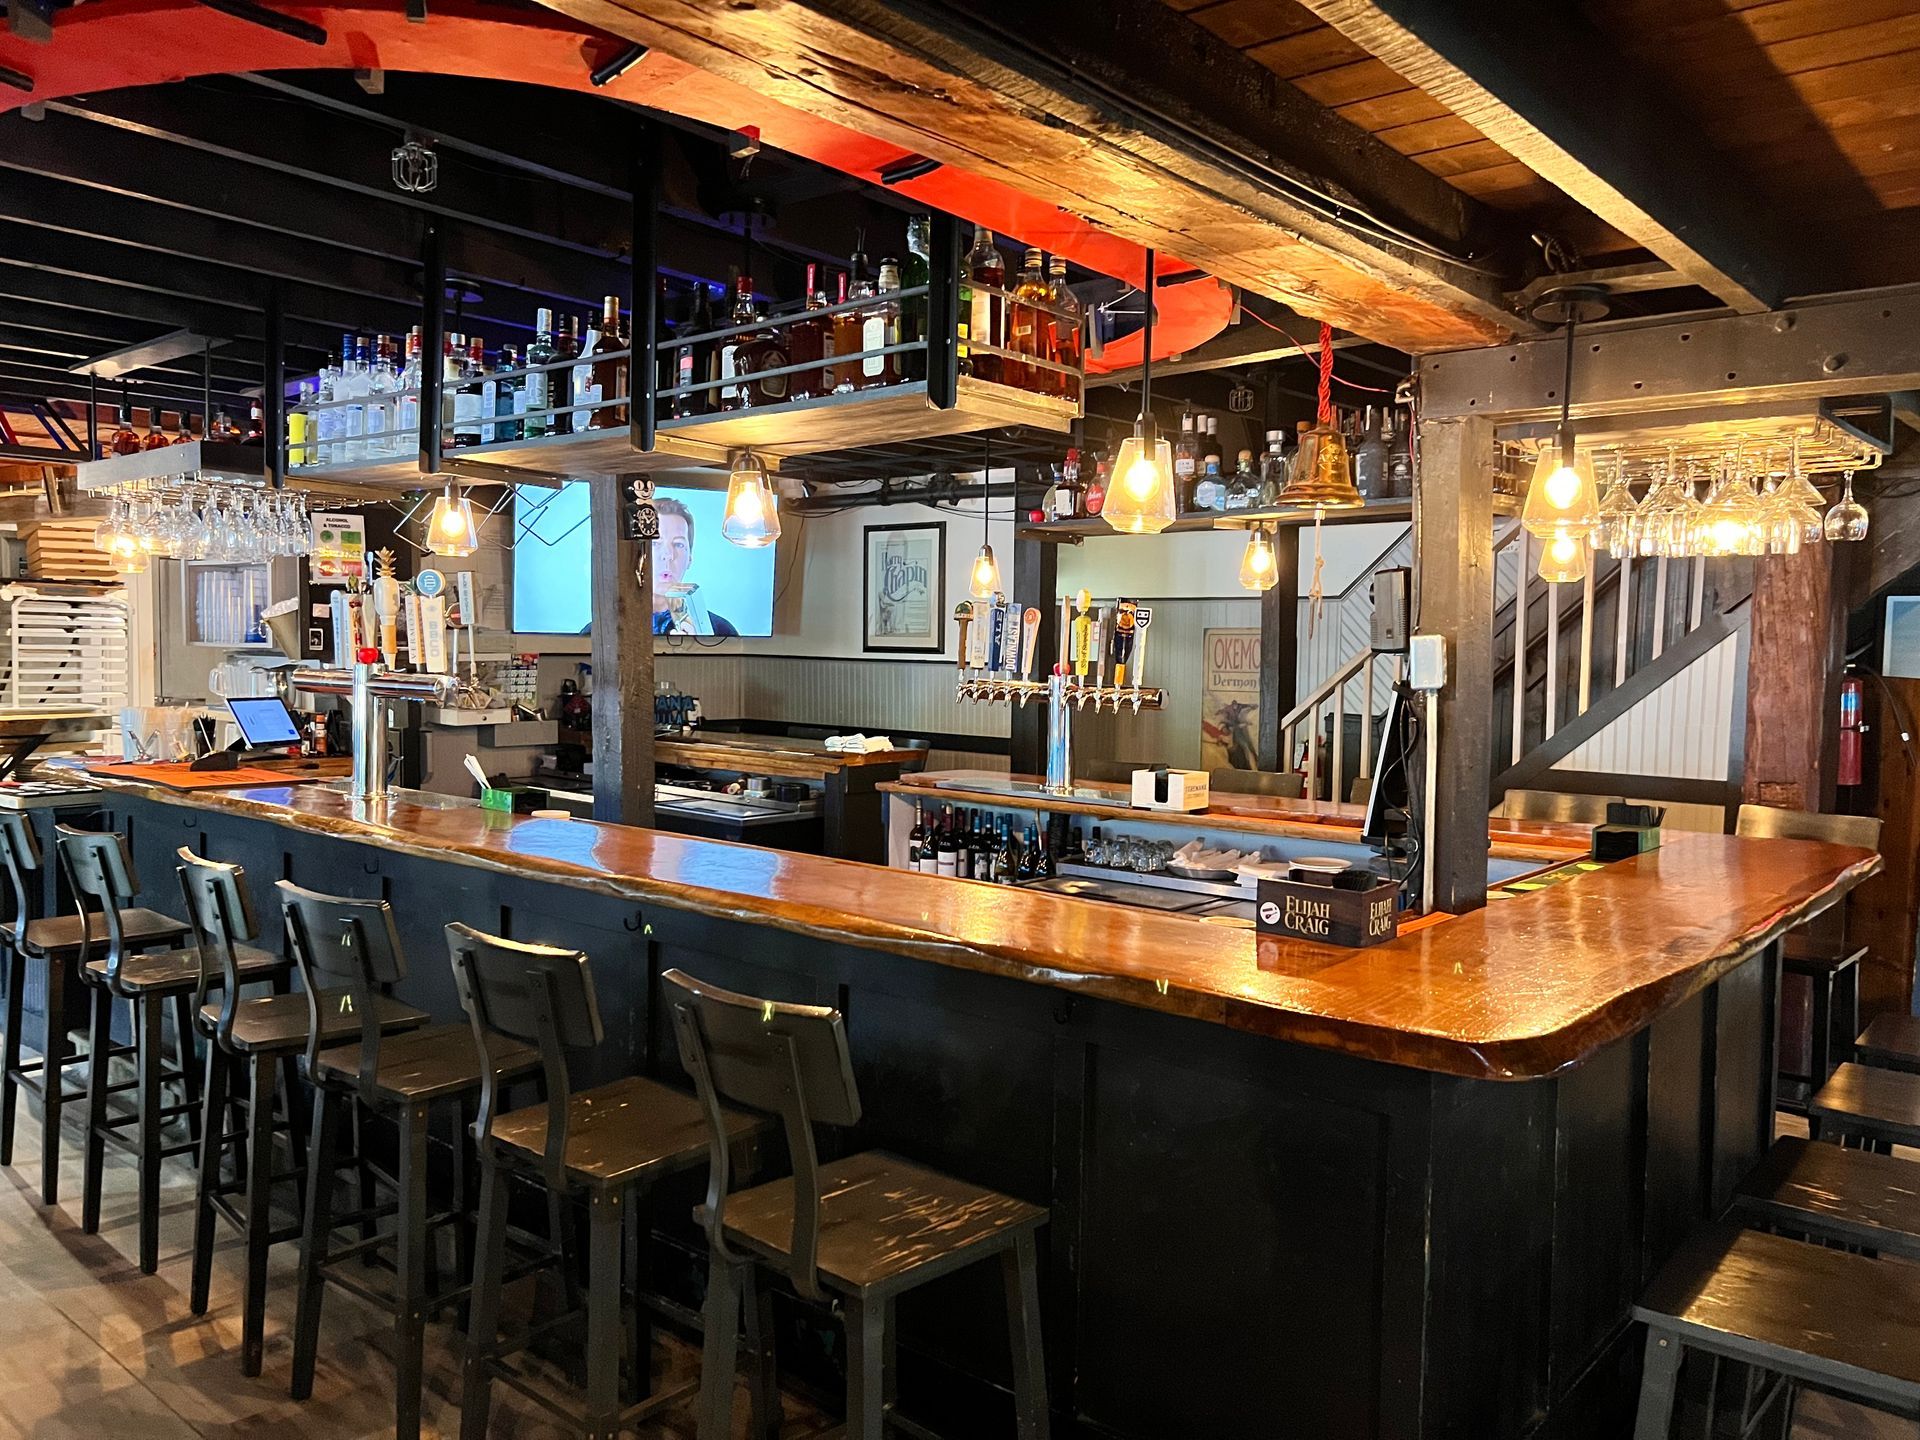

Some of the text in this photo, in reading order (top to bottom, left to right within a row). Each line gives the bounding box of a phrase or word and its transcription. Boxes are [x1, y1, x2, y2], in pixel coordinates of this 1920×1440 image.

[883, 564, 928, 602] Chapin
[994, 610, 1003, 646] ALE
[1005, 620, 1019, 670] DOWNEAST
[1213, 638, 1261, 670] OKEMO
[1213, 673, 1261, 689] Vermon
[1286, 895, 1331, 919] ELIJAH
[1370, 898, 1393, 919] ELIJAH
[1284, 911, 1331, 936] CRAIG
[1369, 914, 1392, 936] CRAIG
